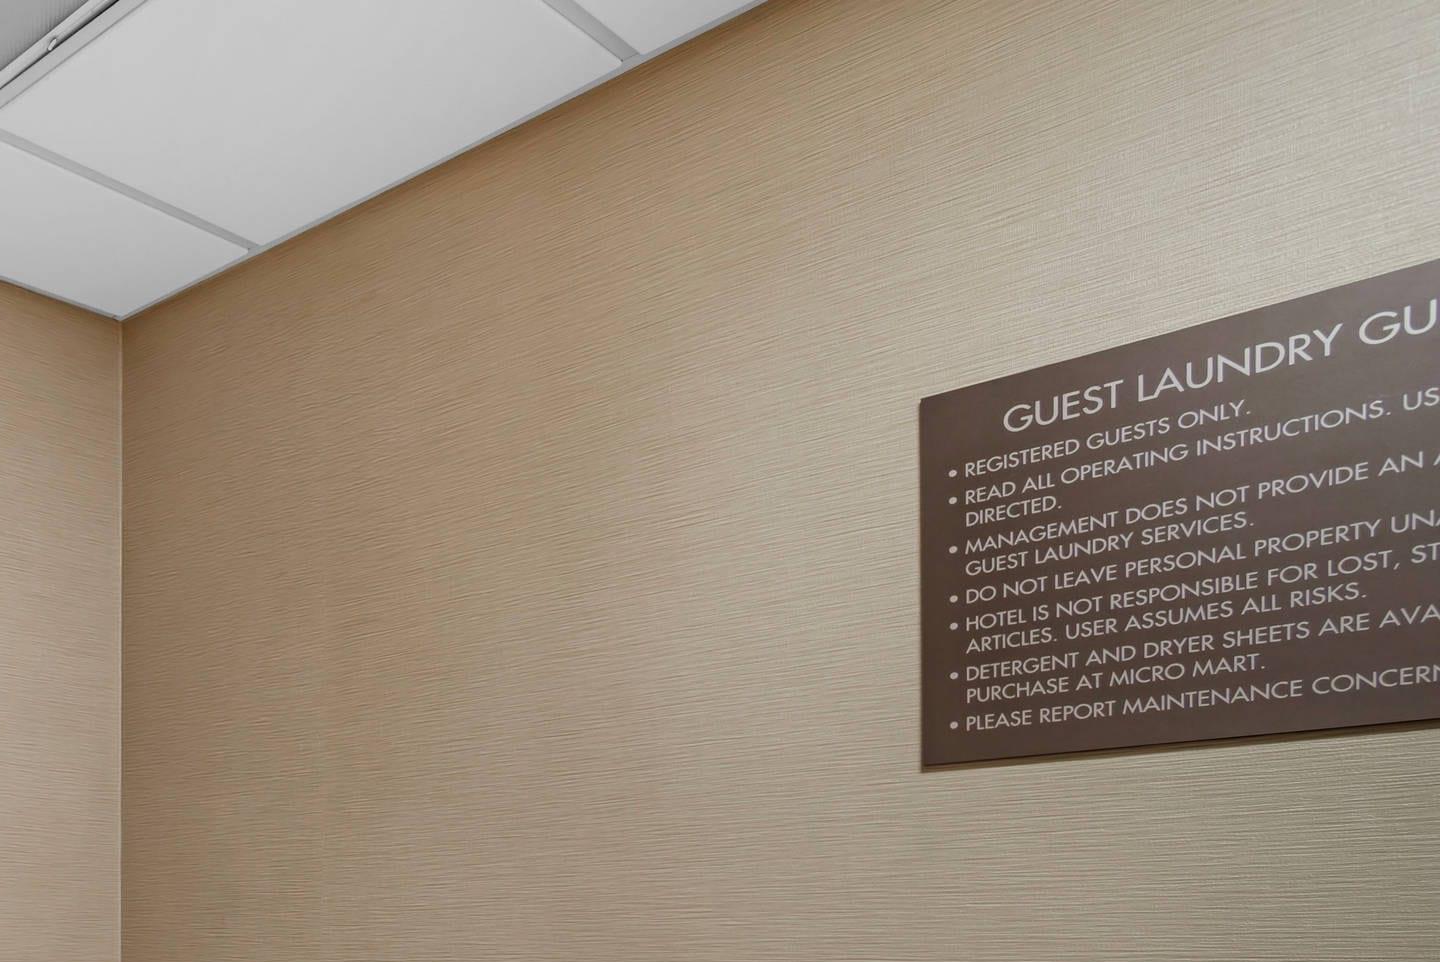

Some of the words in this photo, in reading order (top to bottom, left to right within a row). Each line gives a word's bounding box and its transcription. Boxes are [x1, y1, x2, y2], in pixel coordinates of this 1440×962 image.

[1003, 379, 1124, 432] GUEST
[1137, 323, 1343, 403] LAUNDRY
[1359, 299, 1437, 344] GU
[965, 439, 1080, 477] REGISTERED
[1086, 417, 1170, 449] GUESTS
[1178, 400, 1251, 428] ONLY.
[966, 482, 1016, 505] READ
[1022, 473, 1055, 493] ALL
[1061, 444, 1189, 484] OPERATING
[1197, 400, 1391, 456] INSTRUCTIONS.
[1403, 387, 1440, 410] US
[965, 511, 1118, 555] MANAGEMENT
[1126, 498, 1187, 524] DOES
[1196, 485, 1250, 511] NOT
[1258, 462, 1368, 499] PROVIDE
[1378, 451, 1423, 476] AN
[966, 496, 1061, 527] DIRECTED.
[965, 551, 1028, 576] GUEST
[1035, 532, 1133, 564] LAUNDRY
[1141, 512, 1254, 545] SERVICES.
[966, 586, 996, 604] DO
[1003, 576, 1048, 598] NOT
[1055, 564, 1117, 589] LEAVE
[1126, 544, 1246, 578] PERSONAL
[1254, 519, 1381, 556] PROPERTY
[1391, 509, 1440, 533] UN
[966, 609, 1027, 631] HOTEL
[1033, 605, 1049, 621] IS
[1056, 596, 1103, 618] NOT
[1110, 572, 1258, 610] RESPONSIBLE
[1268, 563, 1318, 586] FOR
[1328, 550, 1400, 576] LOST,
[1411, 542, 1440, 563] ST
[966, 627, 1057, 654] ARTICLES.
[1066, 618, 1118, 639] USER
[1124, 601, 1233, 631] ASSUMES
[1241, 594, 1282, 615] ALL
[1291, 582, 1366, 608] RISKS.
[966, 652, 1079, 681] DETERGENT
[1085, 645, 1136, 666] AND
[1144, 635, 1215, 658] DRYER
[1223, 621, 1310, 648] SHEETS
[1318, 613, 1369, 636] ARE
[967, 677, 1069, 703] PURCHASE
[1076, 672, 1103, 691] AT
[1110, 663, 1185, 687] MICRO
[1193, 653, 1265, 677] MART.
[966, 709, 1032, 731] PLEASE
[1040, 700, 1116, 723] REPORT
[1122, 680, 1303, 715] MAINTENANCE
